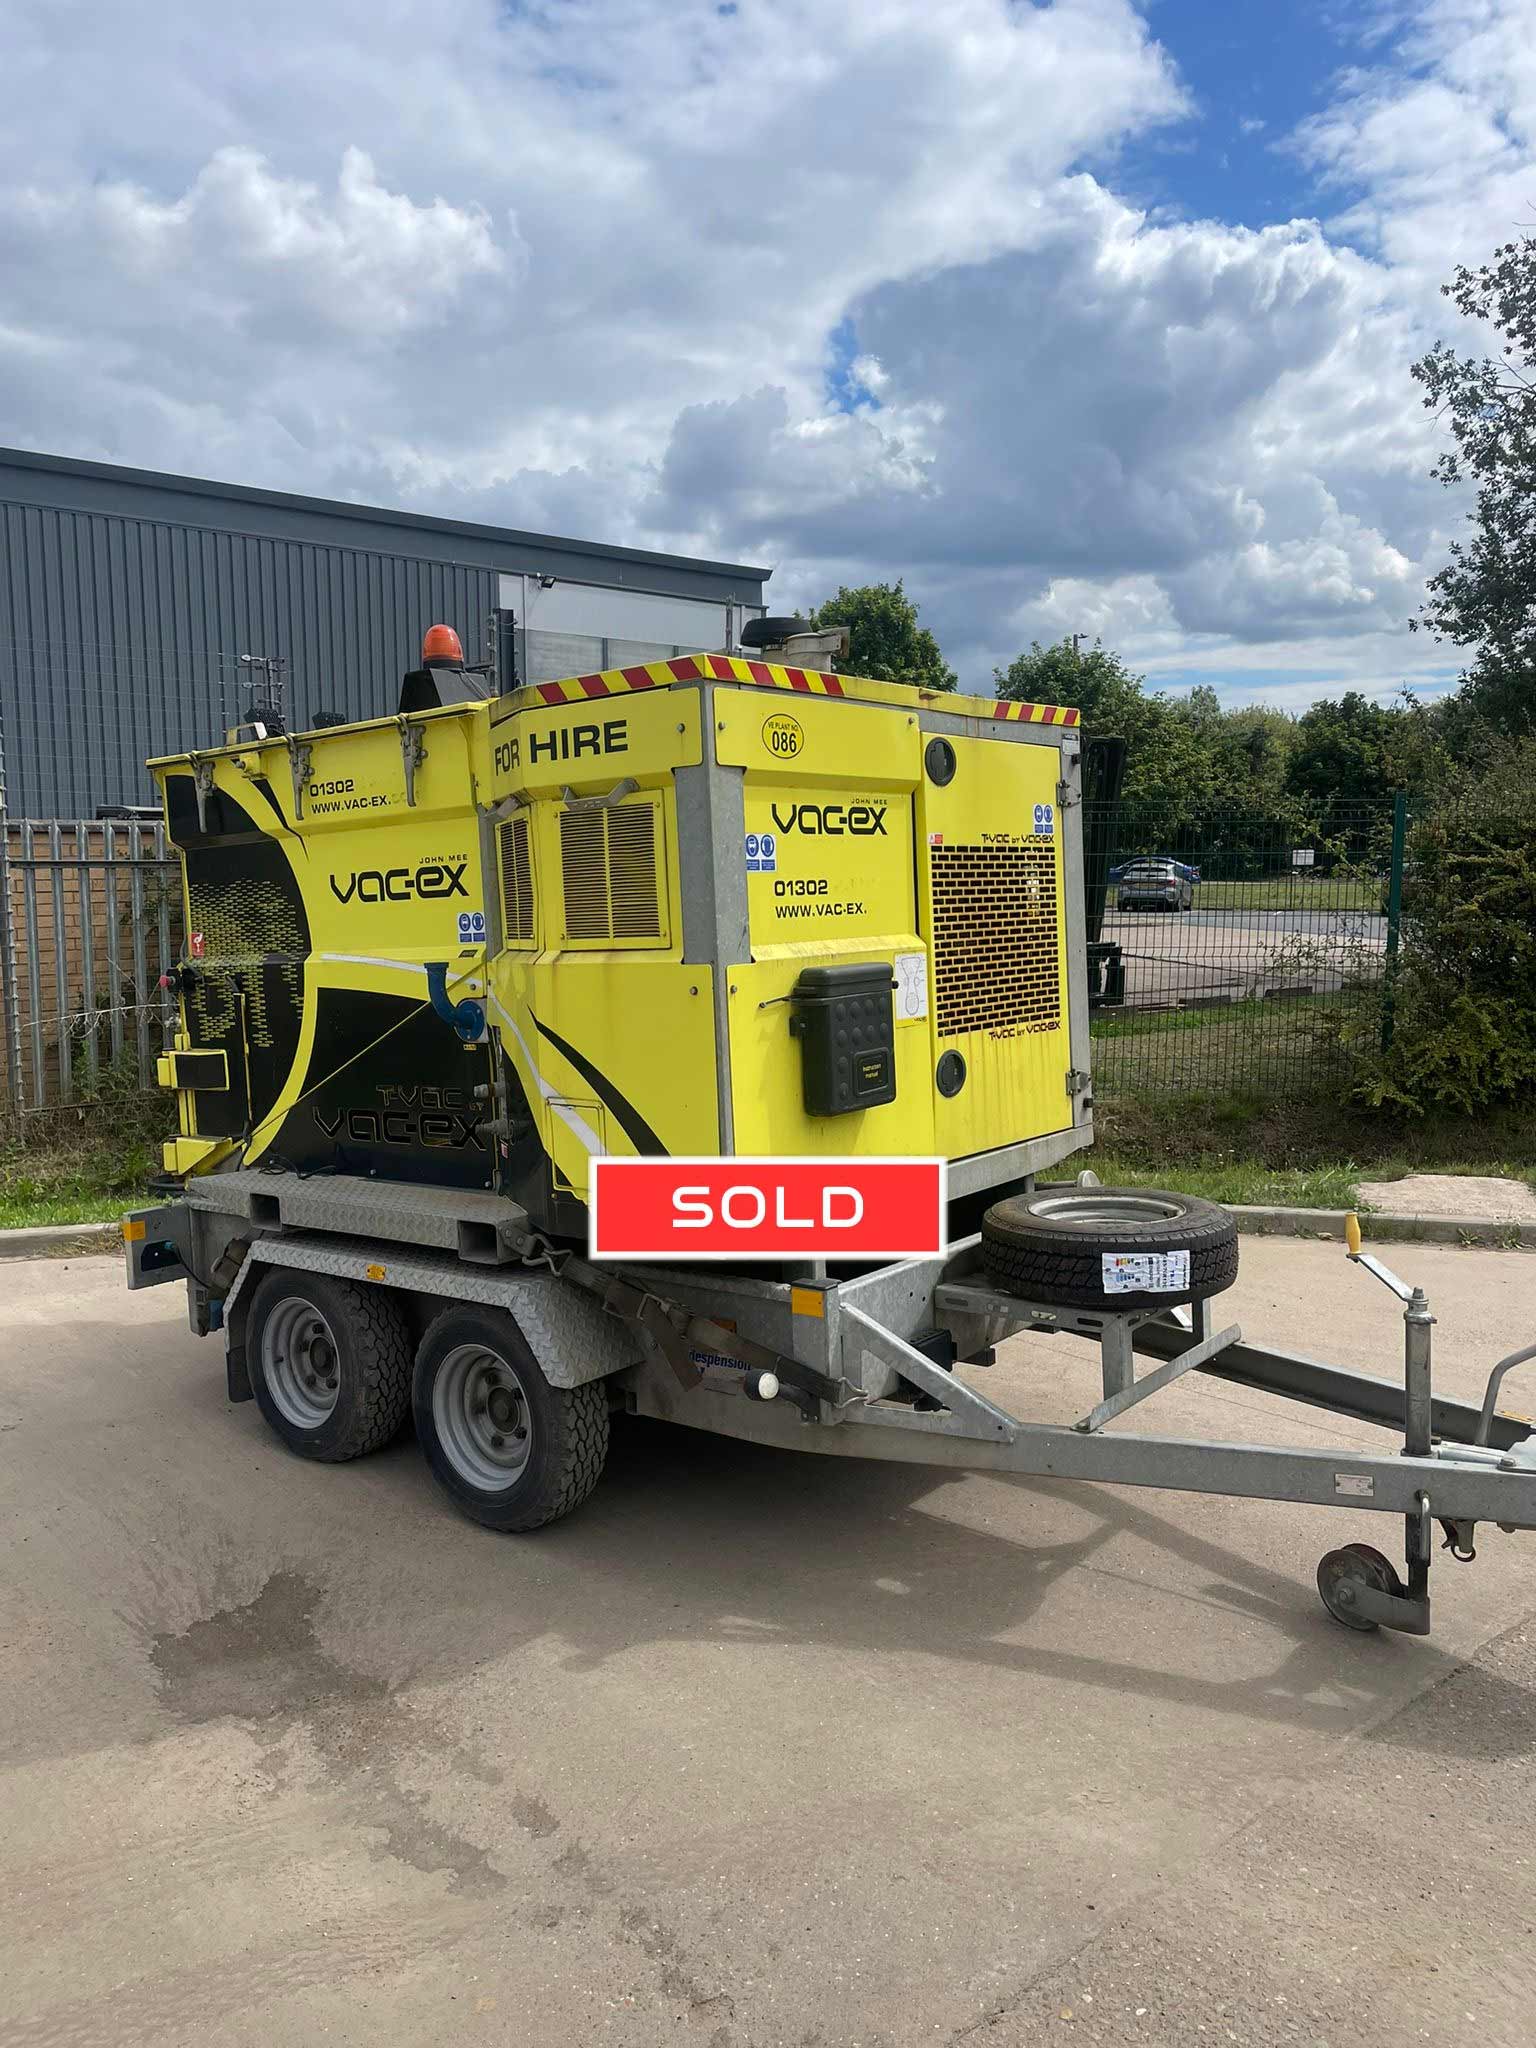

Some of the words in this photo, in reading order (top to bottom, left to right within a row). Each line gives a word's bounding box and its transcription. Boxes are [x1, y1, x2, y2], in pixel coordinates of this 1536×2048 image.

[494, 738, 520, 776] FOR
[529, 720, 628, 763] HIRE
[772, 731, 797, 753] 086
[309, 779, 355, 797] 01302
[419, 856, 444, 864] JOHN
[448, 854, 468, 862] MEE
[774, 879, 828, 897] 01302
